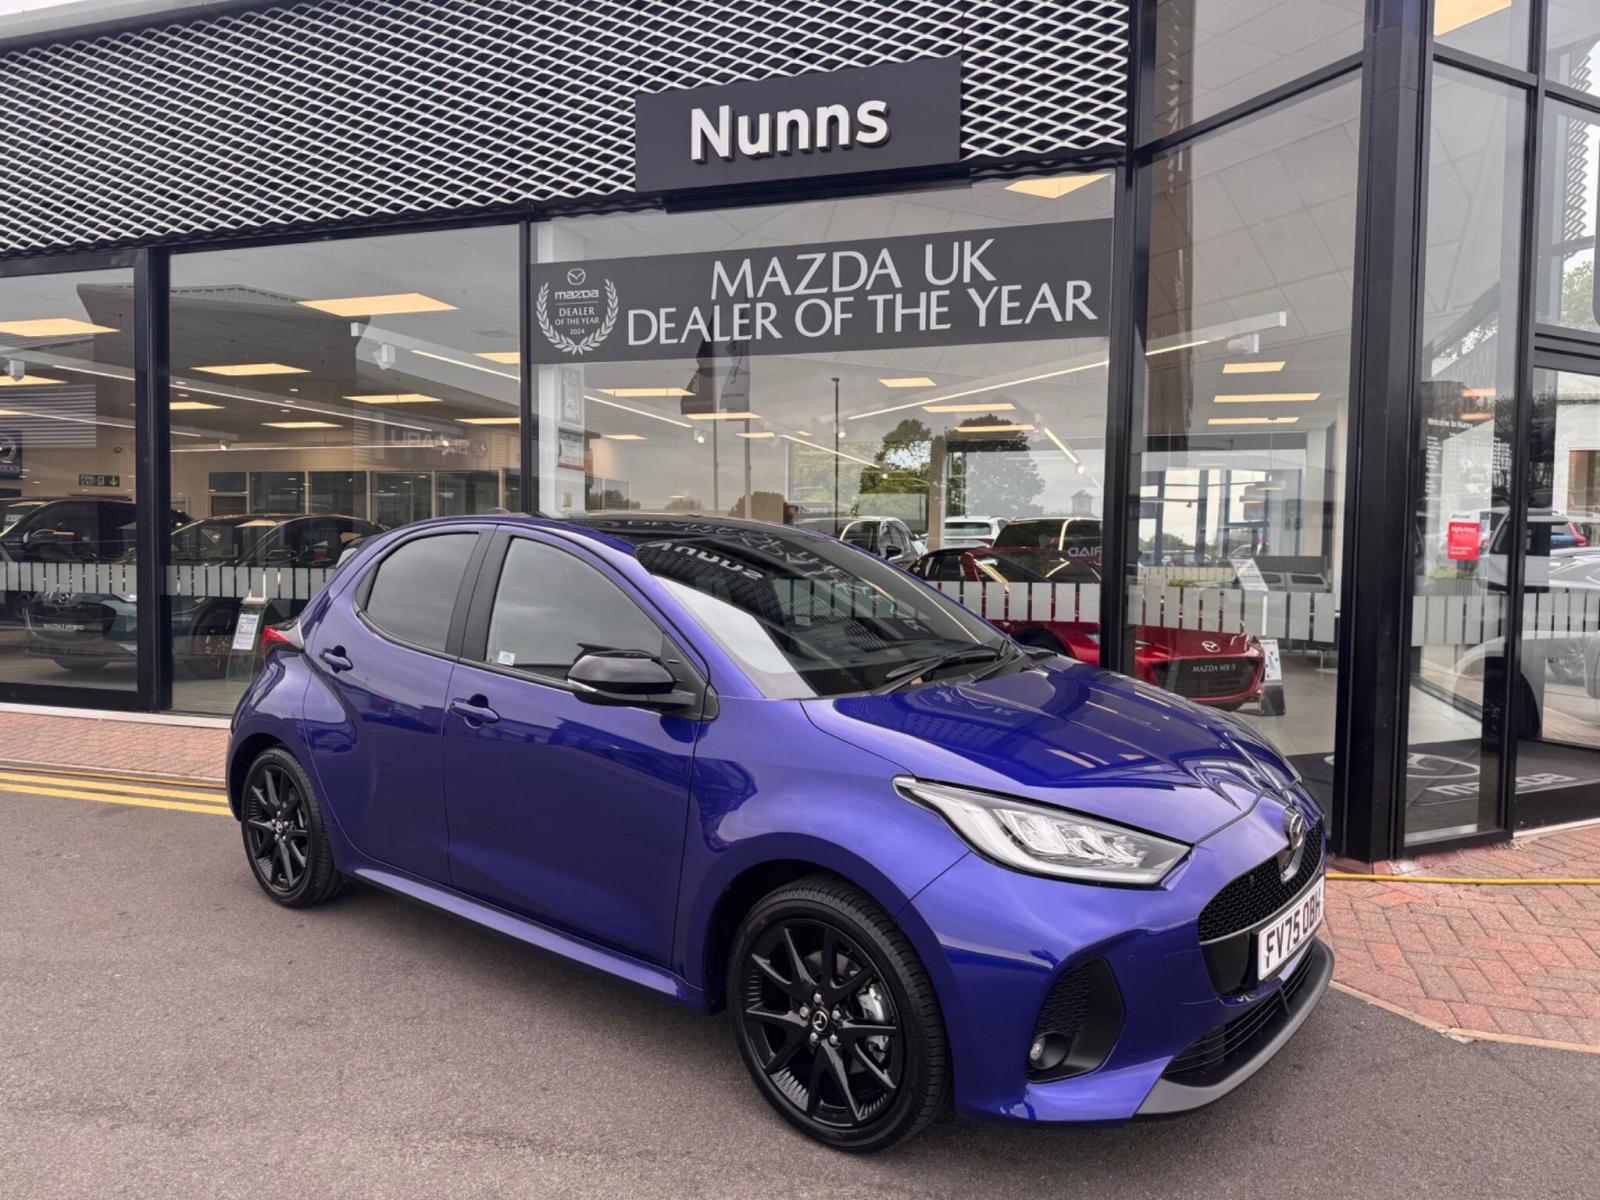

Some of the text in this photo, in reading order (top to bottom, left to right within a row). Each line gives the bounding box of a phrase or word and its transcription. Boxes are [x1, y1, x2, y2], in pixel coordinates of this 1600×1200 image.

[690, 100, 890, 163] Nunns
[711, 238, 996, 300] MAZDA UK
[555, 289, 599, 300] mazda
[559, 306, 595, 317] DEALER
[555, 316, 599, 326] OF THE YEAR
[627, 279, 1098, 346] DEALER OF THE YEAR
[1192, 663, 1236, 673] MAZDA MX-5
[1265, 910, 1301, 969] FV75
